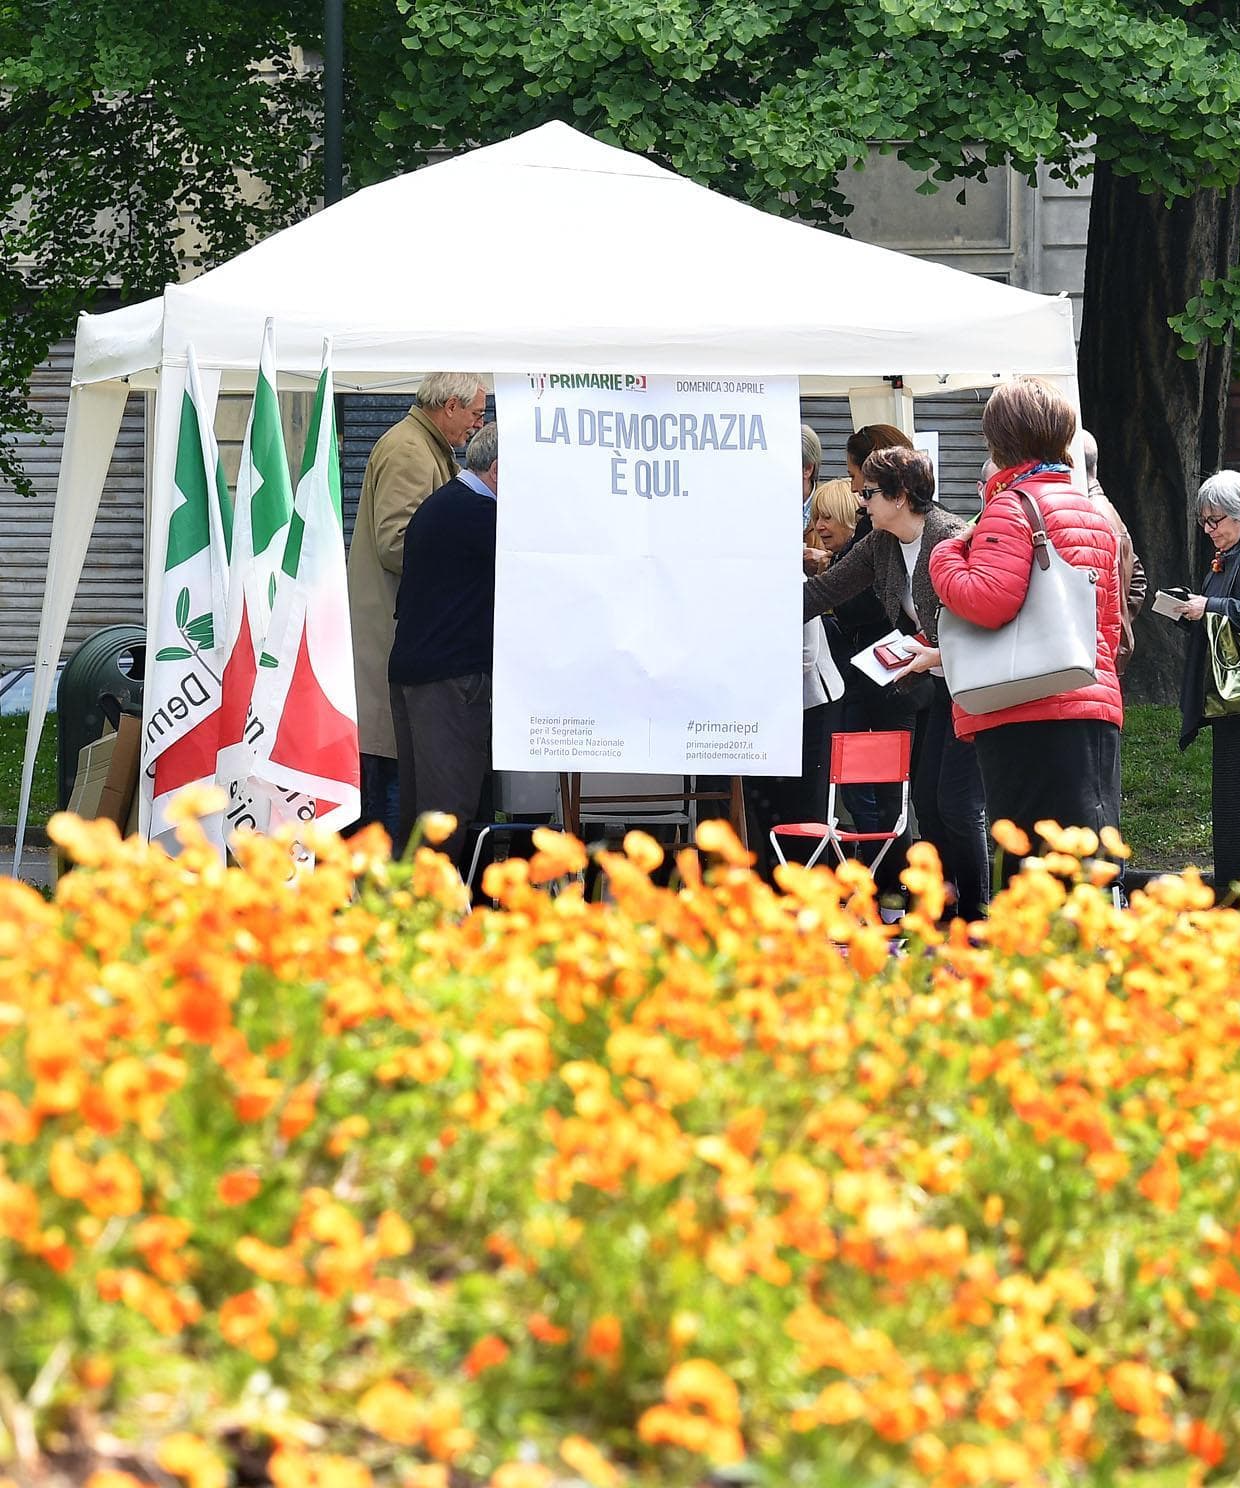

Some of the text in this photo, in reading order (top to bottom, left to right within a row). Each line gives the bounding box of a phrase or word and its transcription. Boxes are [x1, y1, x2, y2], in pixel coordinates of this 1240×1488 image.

[549, 373, 622, 391] PRIMARIE
[677, 381, 765, 394] DOMENICA 30 APRILE
[534, 407, 768, 452] LA DEMOCRAZIA
[610, 450, 689, 499] È QUI.
[530, 716, 596, 726] Elezioni primarie
[529, 727, 543, 736] per
[551, 726, 593, 737] Segretario
[687, 720, 759, 736] #primariepd
[536, 736, 584, 746] l'Assemblea
[585, 737, 625, 747] Nazionale
[686, 741, 754, 750] primariepd2017.it
[529, 747, 622, 758] del Partito Democratico
[686, 751, 768, 761] partitodemocratico.it
